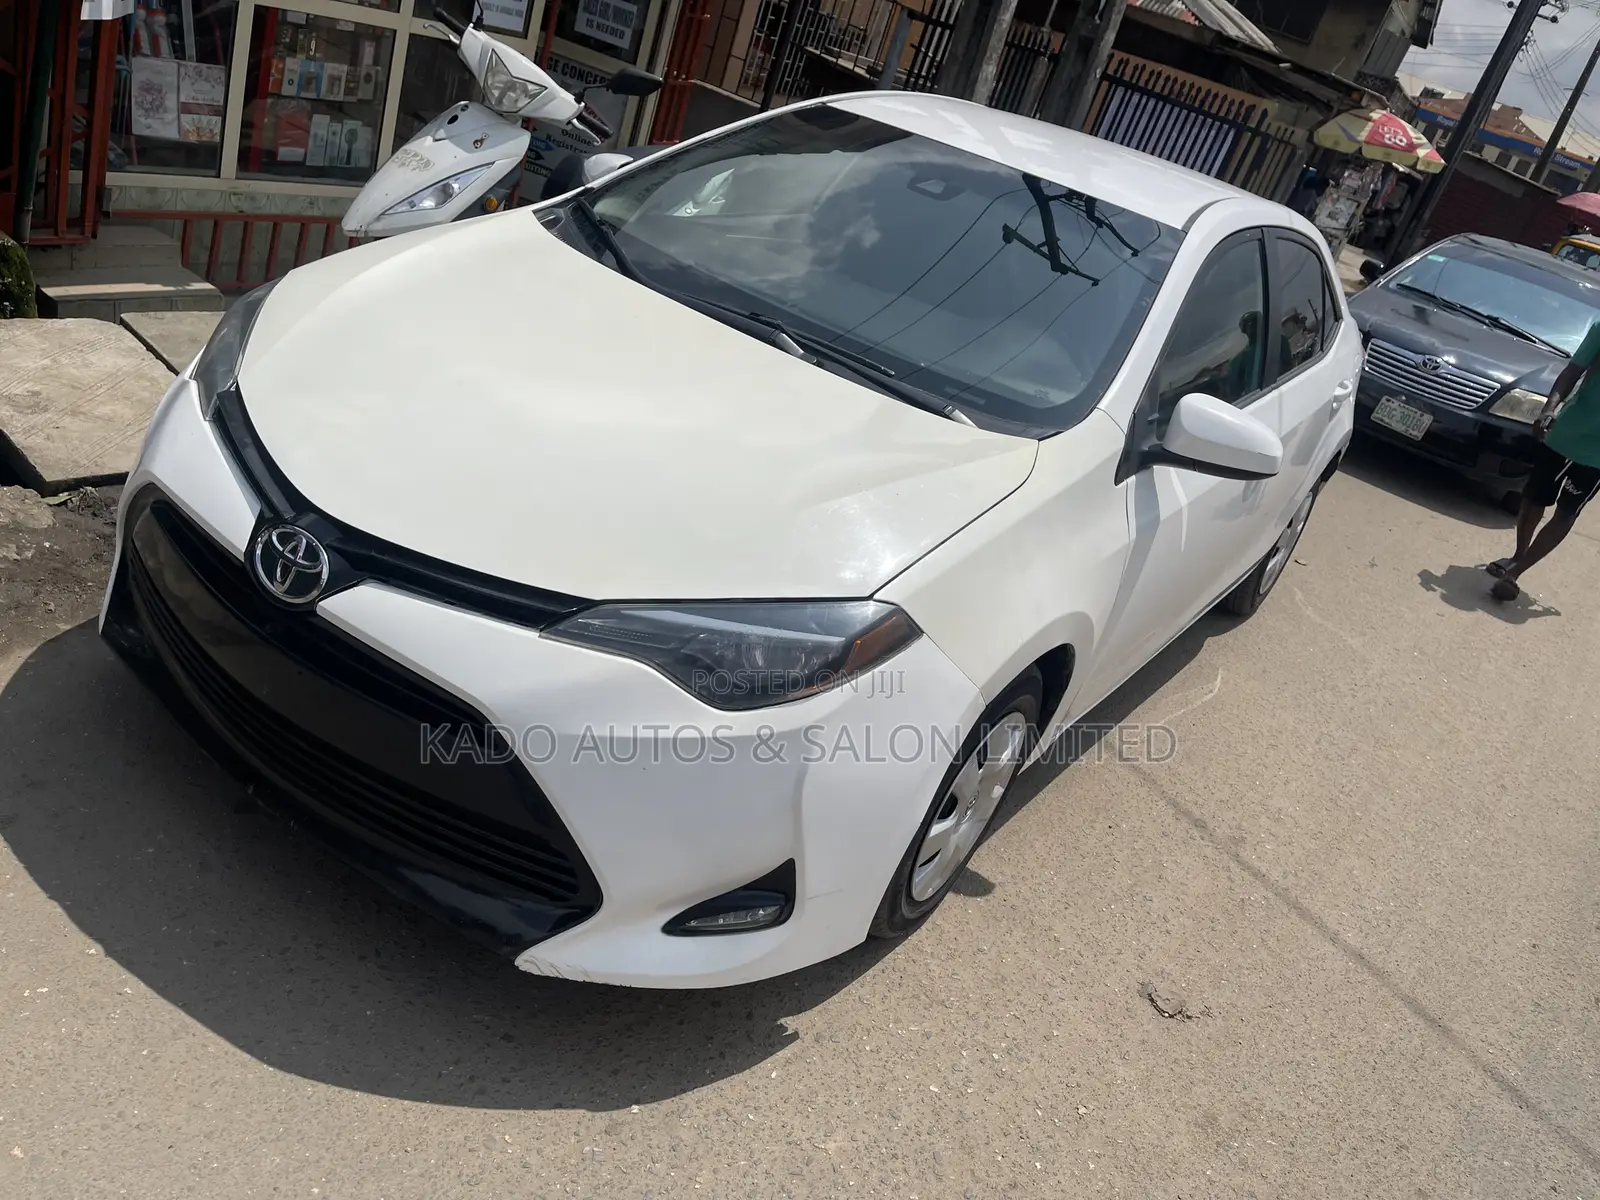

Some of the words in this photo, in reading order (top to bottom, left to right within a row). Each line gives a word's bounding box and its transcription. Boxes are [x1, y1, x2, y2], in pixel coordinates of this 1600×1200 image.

[585, 17, 595, 29] IS
[595, 20, 626, 40] NEEDED
[561, 62, 608, 84] CONCEP
[1384, 133, 1407, 147] GO
